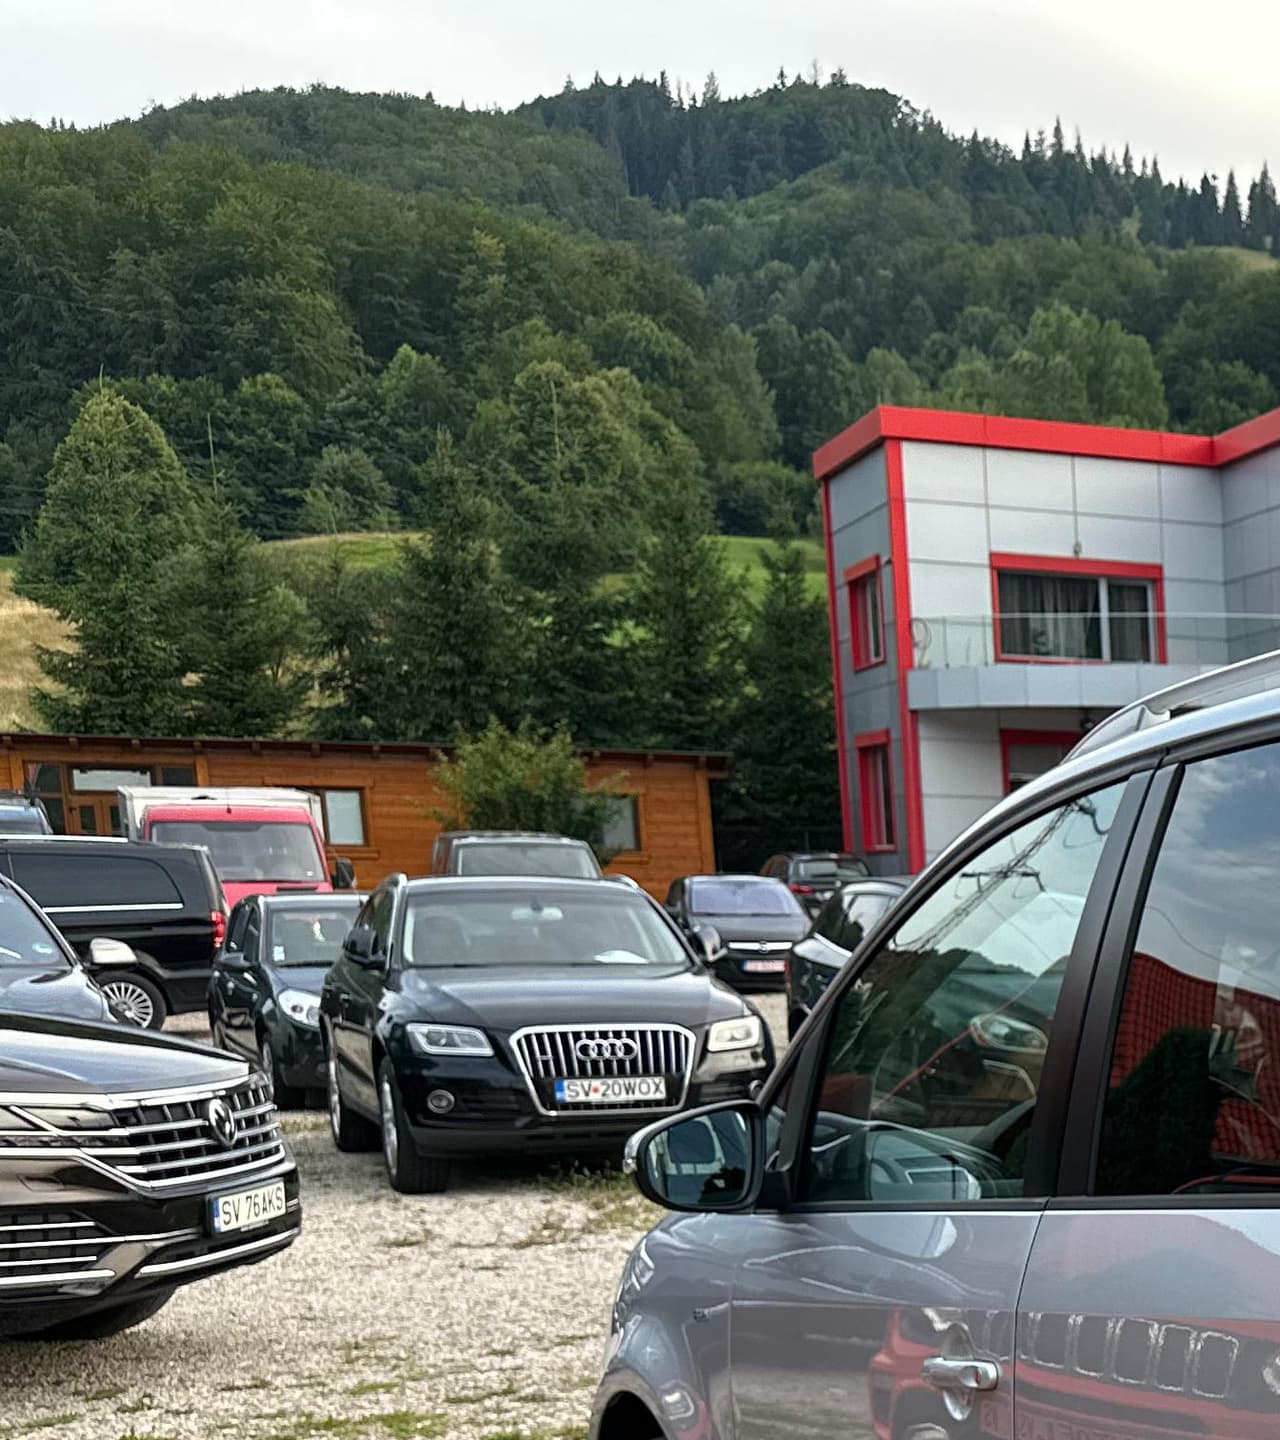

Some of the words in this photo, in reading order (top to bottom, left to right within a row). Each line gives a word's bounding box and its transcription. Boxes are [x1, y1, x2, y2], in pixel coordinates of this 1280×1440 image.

[567, 1080, 592, 1098] SV
[600, 1078, 664, 1098] 20WOX
[221, 1198, 240, 1225] SV
